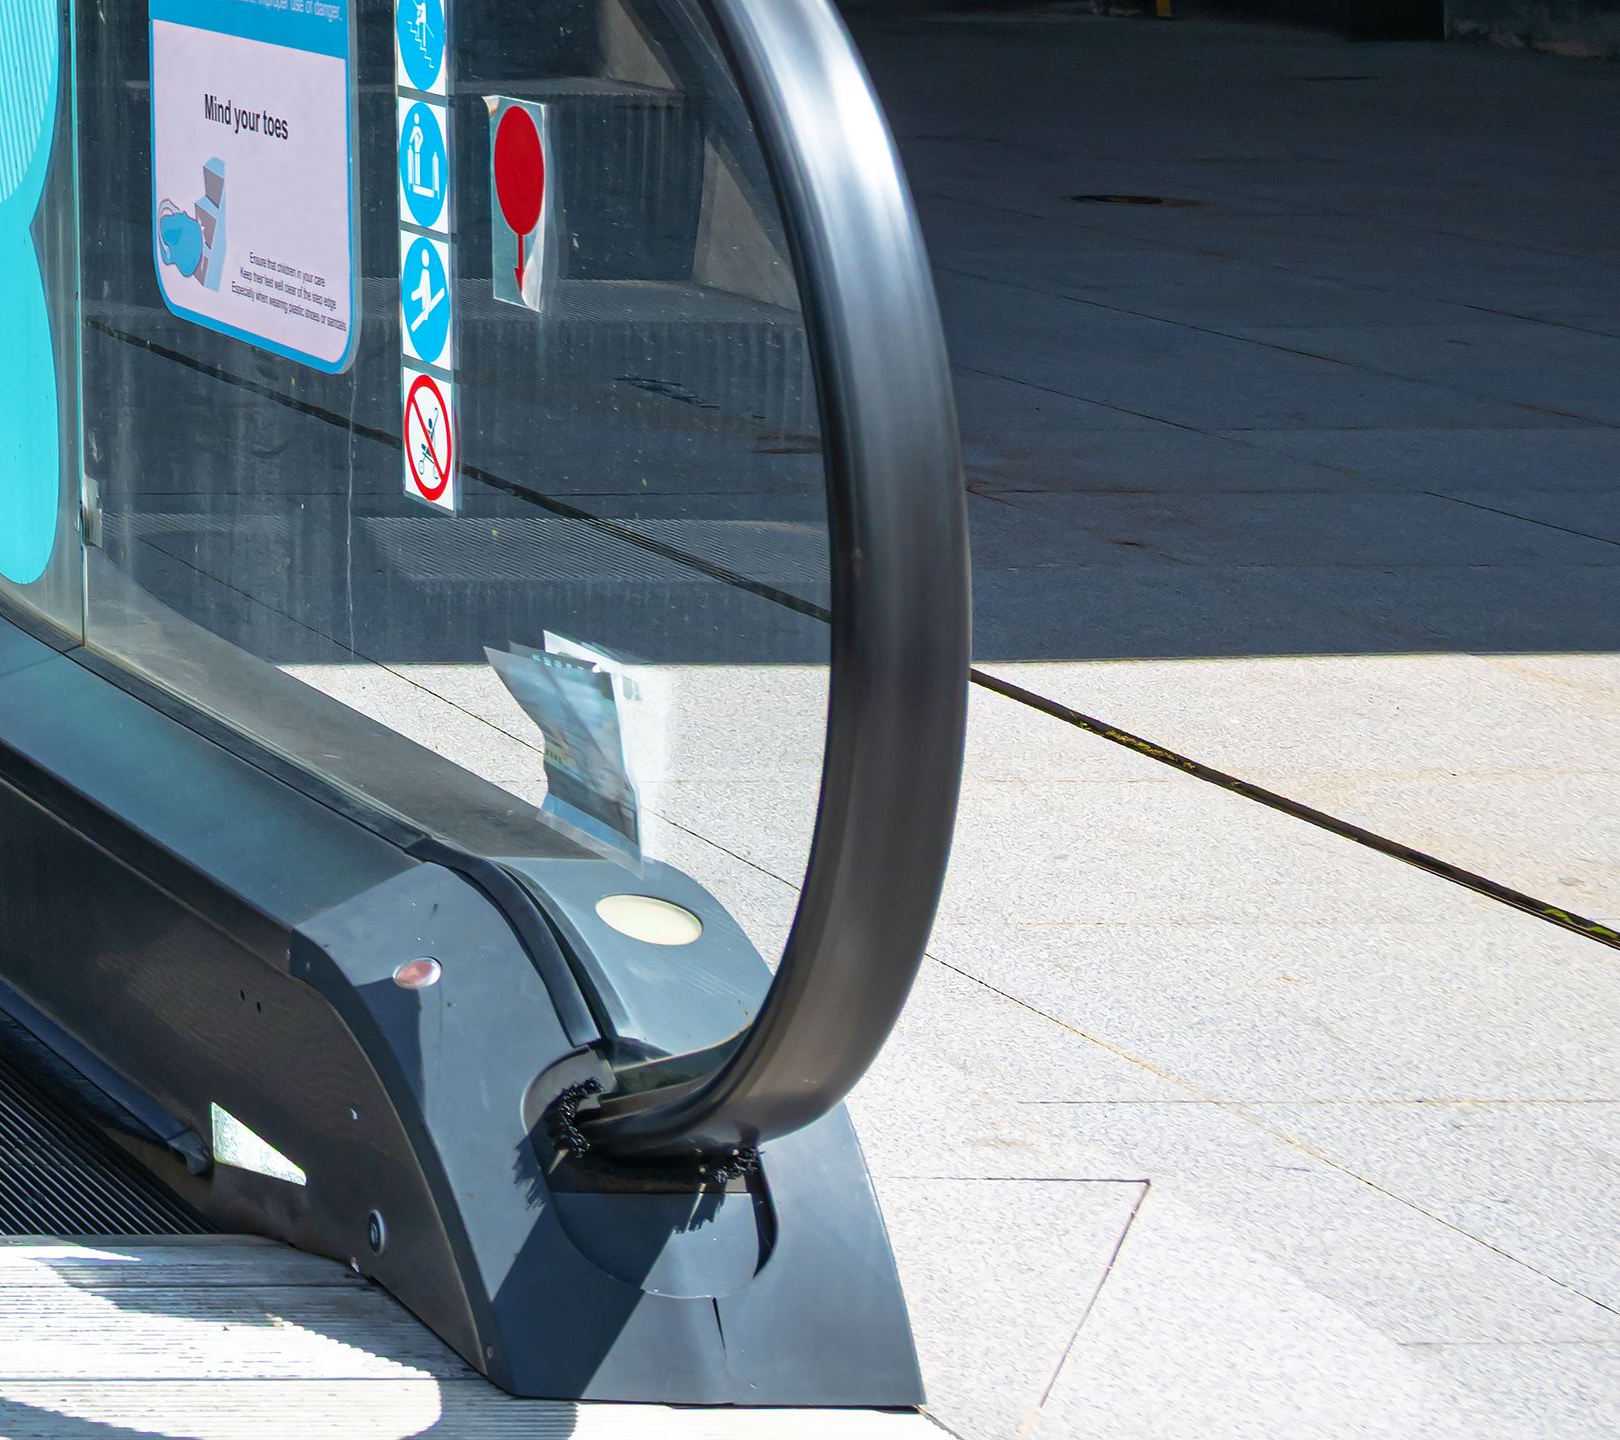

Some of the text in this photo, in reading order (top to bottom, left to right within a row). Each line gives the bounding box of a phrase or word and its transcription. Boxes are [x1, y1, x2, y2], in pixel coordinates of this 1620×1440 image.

[204, 93, 288, 140] Mind your toes
[240, 266, 252, 282] Keep
[274, 280, 283, 291] well
[285, 283, 296, 296] clear
[303, 287, 311, 301] the
[323, 297, 337, 312] edge
[249, 251, 267, 268] Ensure
[267, 258, 277, 271] that
[277, 263, 296, 277] children
[303, 272, 314, 284] your
[314, 275, 325, 287] care
[232, 280, 255, 302] Especially
[255, 291, 269, 304] when
[269, 297, 288, 314] wearing
[305, 308, 320, 323] shoes
